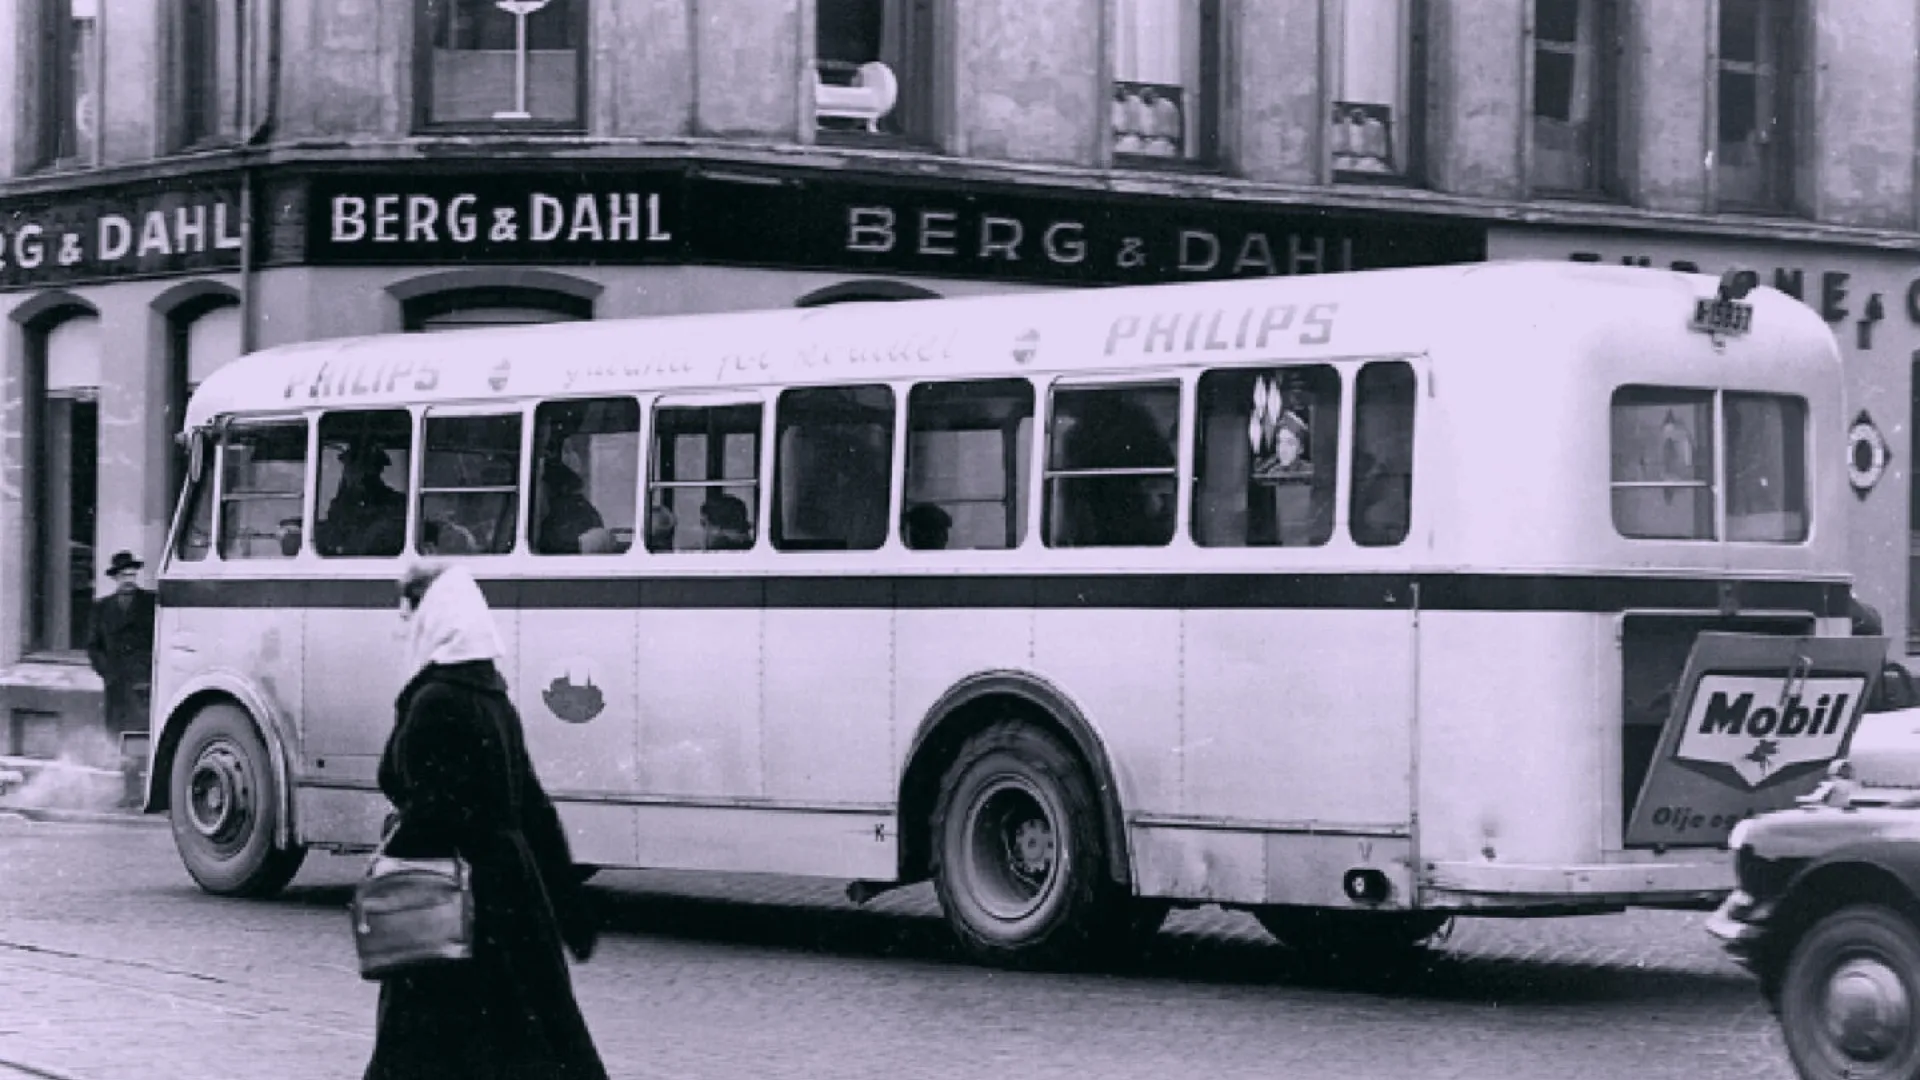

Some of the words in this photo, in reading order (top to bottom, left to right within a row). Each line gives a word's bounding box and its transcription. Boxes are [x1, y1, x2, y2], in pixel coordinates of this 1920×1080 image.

[0, 223, 44, 272] G
[58, 232, 83, 266] &
[97, 202, 242, 261] DAHL
[331, 193, 478, 242] BERG
[488, 207, 519, 242] &
[529, 192, 673, 241] DAHL
[846, 206, 1088, 264] BERG
[1116, 235, 1147, 268] &
[283, 358, 441, 399] PHILIPS
[1102, 301, 1341, 357] PHILIPS
[1698, 691, 1850, 737] Mobil
[1652, 806, 1706, 834] Olje
